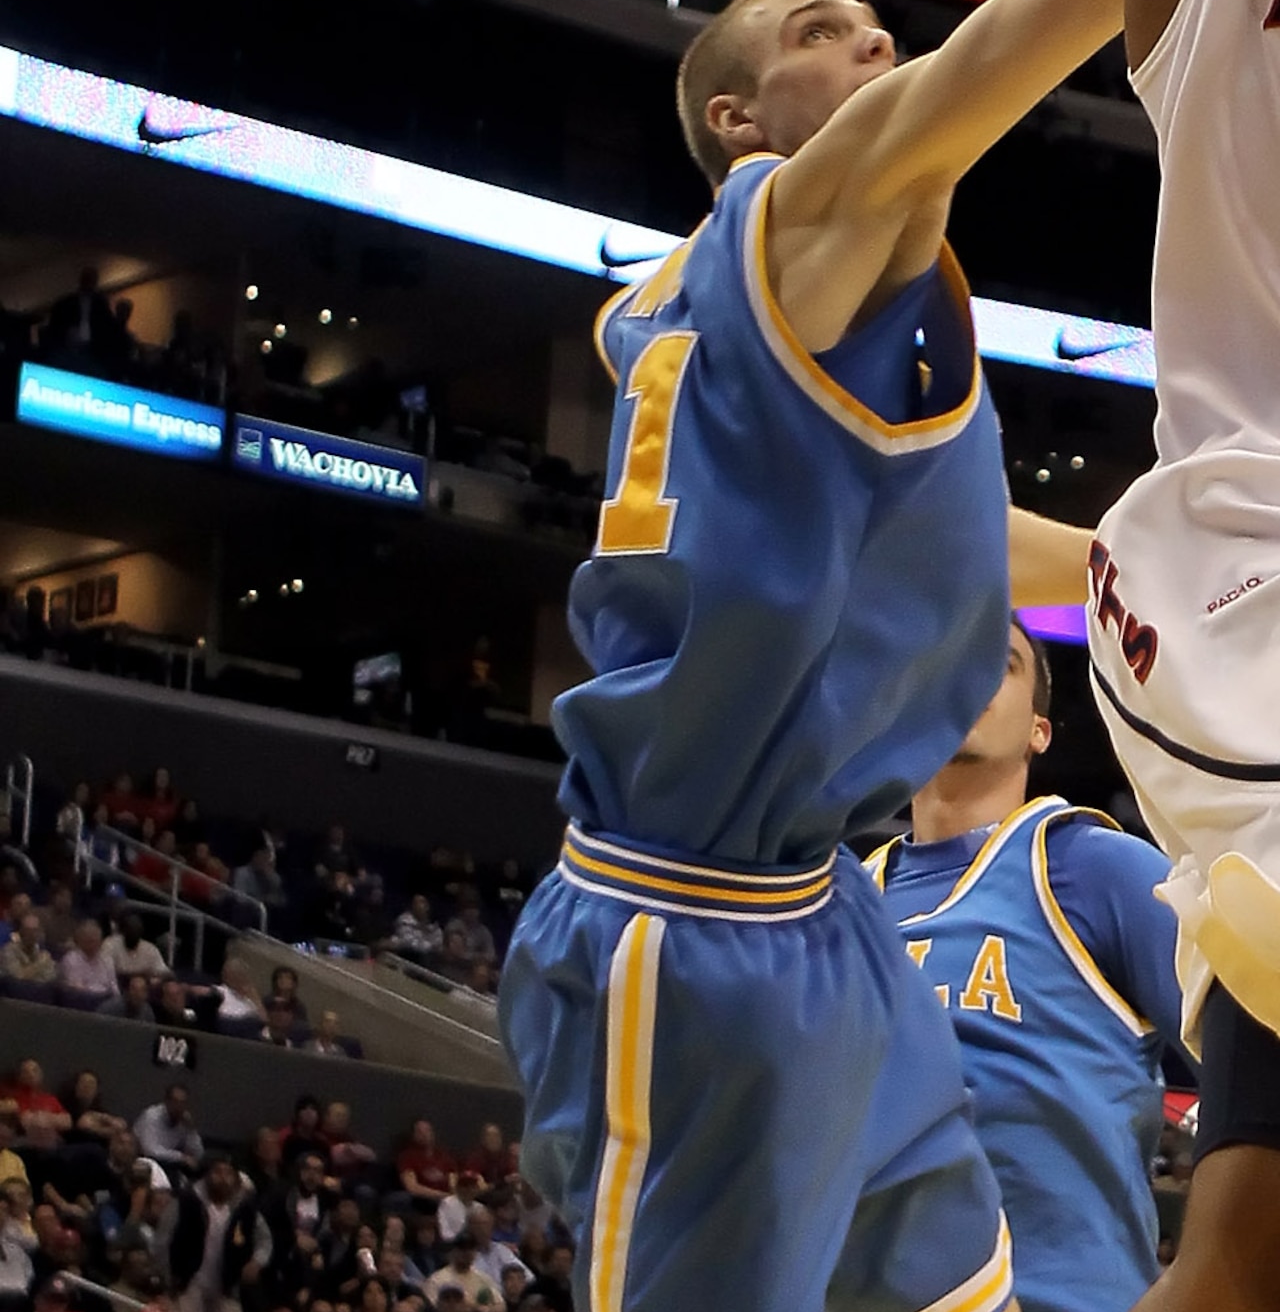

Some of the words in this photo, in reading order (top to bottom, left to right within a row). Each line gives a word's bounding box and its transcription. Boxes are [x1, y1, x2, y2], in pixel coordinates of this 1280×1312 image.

[21, 377, 130, 424] American
[132, 402, 222, 450] Express
[596, 330, 701, 557] 1
[269, 437, 420, 499] WACHOVIA
